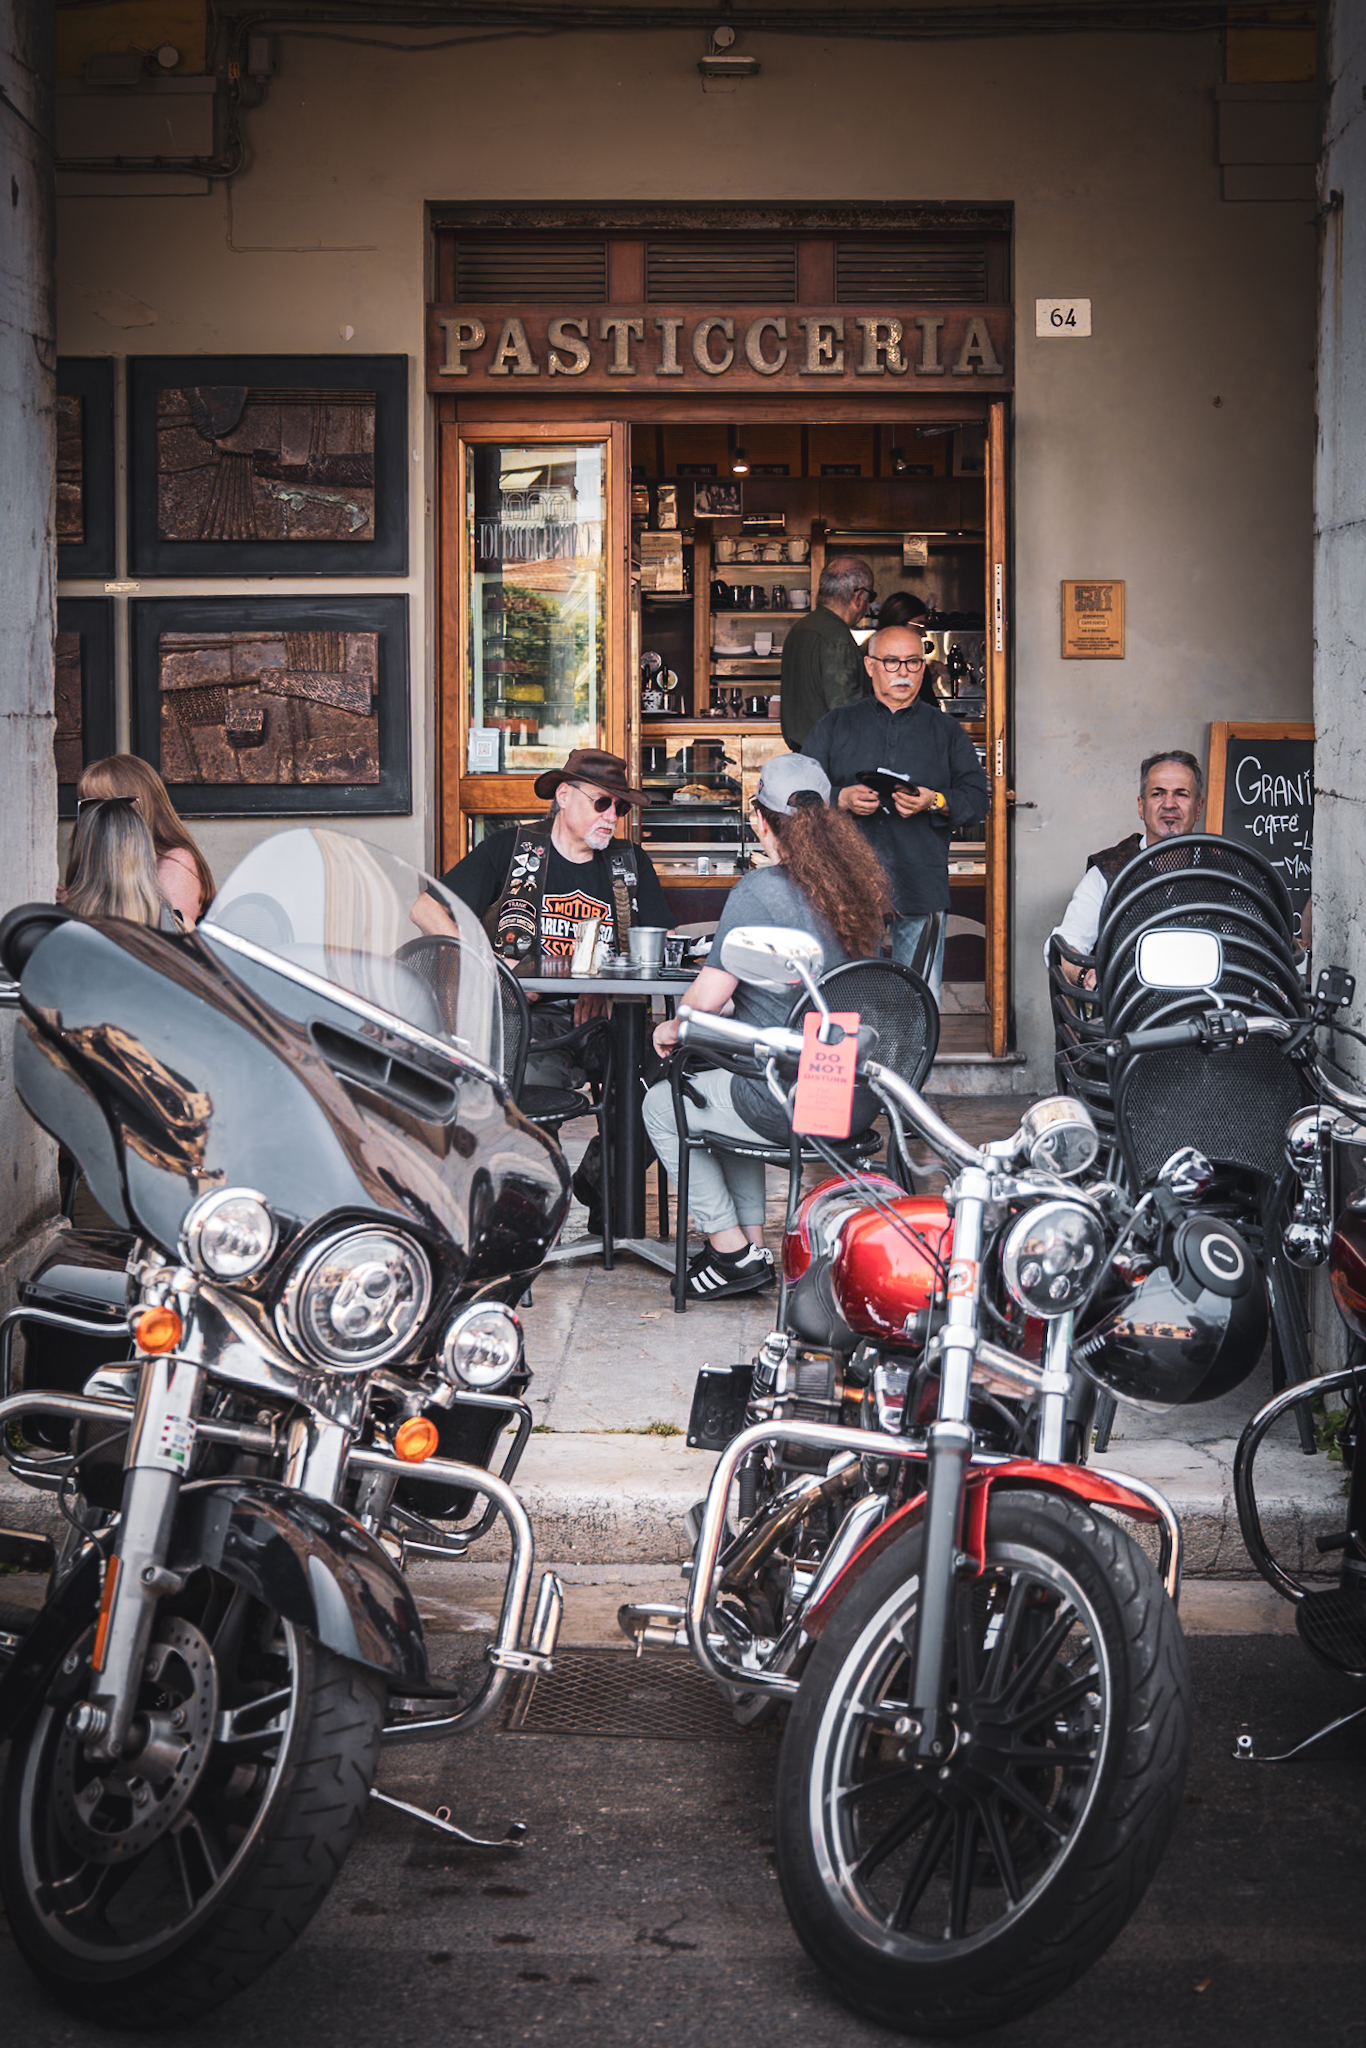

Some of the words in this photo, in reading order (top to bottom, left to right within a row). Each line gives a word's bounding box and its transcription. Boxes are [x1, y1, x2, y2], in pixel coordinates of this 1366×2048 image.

[1049, 307, 1077, 328] 64
[437, 316, 1004, 377] PASTICCERIA
[1235, 755, 1313, 807] GRANi
[554, 898, 602, 919] MOTOR
[815, 1052, 840, 1062] DO
[809, 1063, 845, 1074] NOT
